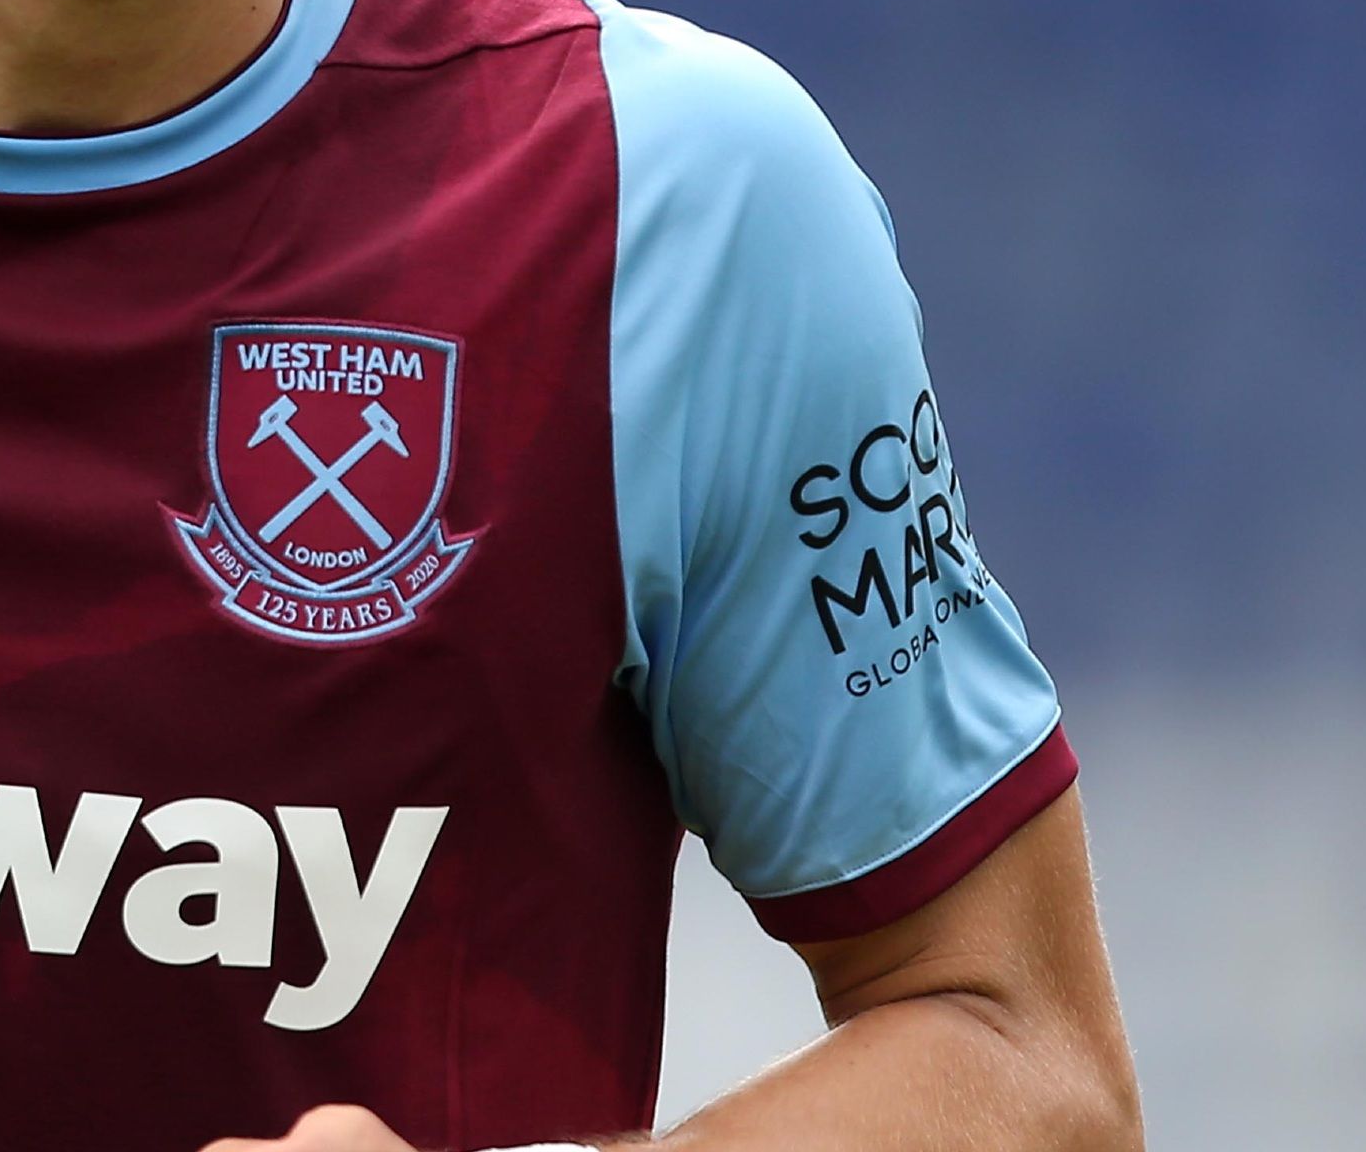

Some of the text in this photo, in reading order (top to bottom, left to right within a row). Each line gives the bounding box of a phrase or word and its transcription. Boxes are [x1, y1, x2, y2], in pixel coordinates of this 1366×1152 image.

[237, 343, 423, 380] WEST HAM
[276, 370, 384, 396] UNITED
[790, 389, 957, 549] SCO
[209, 543, 242, 579] 1895
[285, 542, 367, 569] LONDON
[405, 554, 441, 591] 2020
[811, 492, 971, 655] MAR
[255, 591, 392, 631] 125 YEARS
[846, 624, 939, 697] GLOBA
